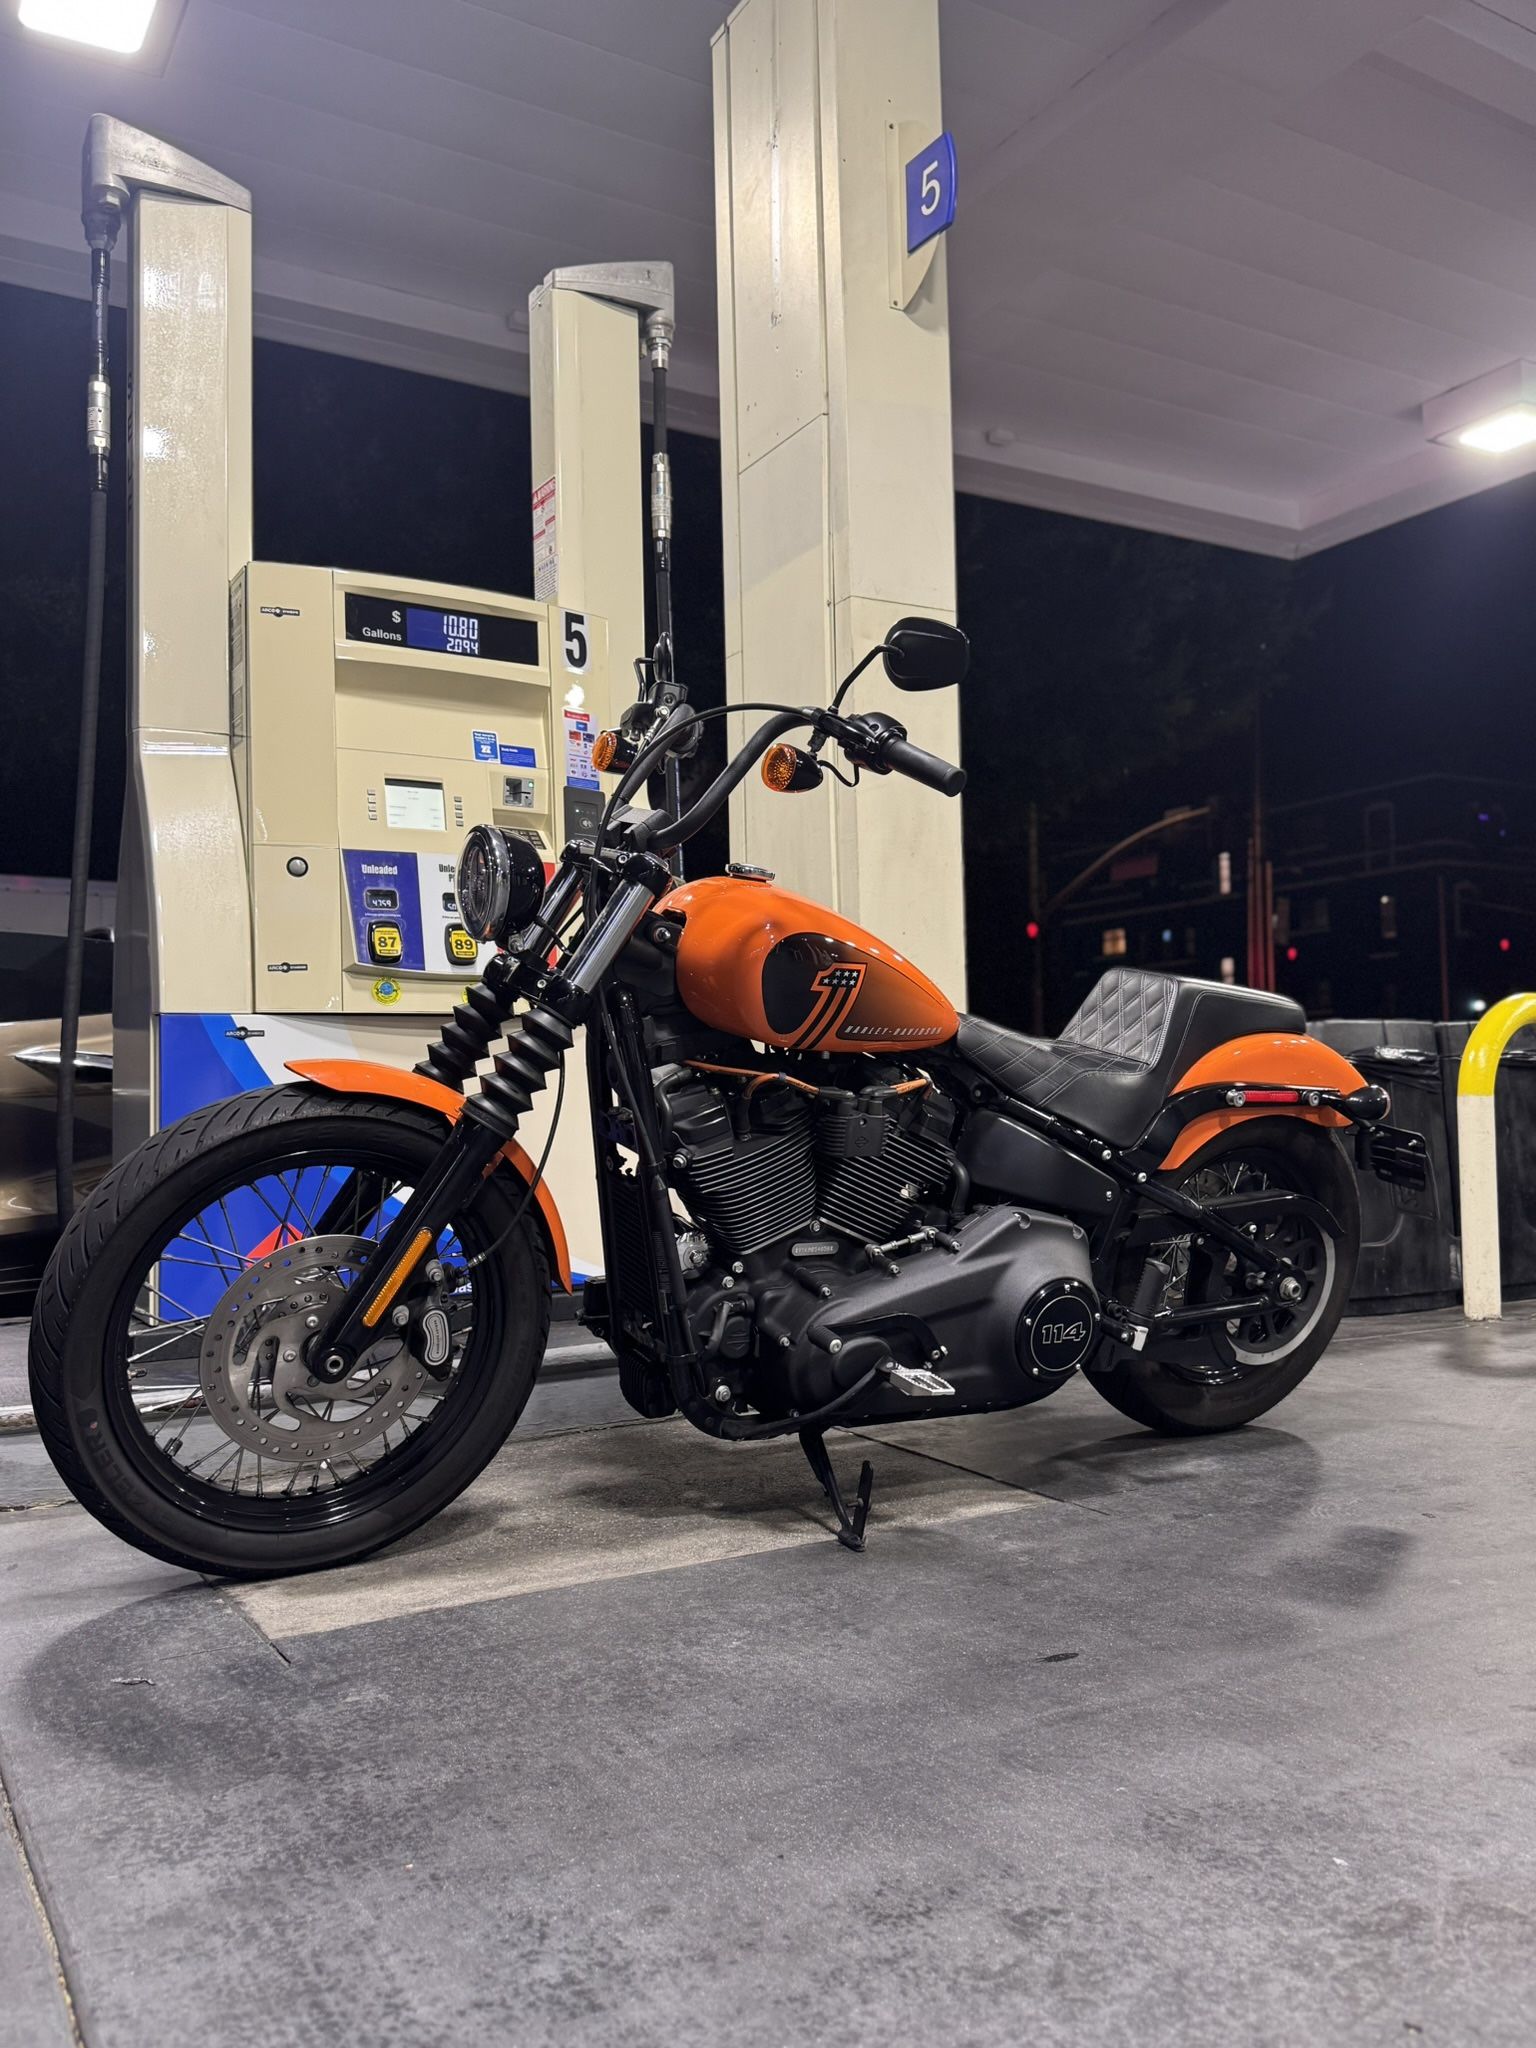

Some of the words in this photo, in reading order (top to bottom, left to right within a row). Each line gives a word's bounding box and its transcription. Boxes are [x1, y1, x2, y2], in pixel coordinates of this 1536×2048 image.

[921, 160, 940, 215] 5
[392, 610, 401, 623] $
[362, 627, 402, 641] Gallons
[565, 611, 587, 668] 5
[361, 864, 398, 874] Unleaded
[438, 863, 455, 873] Unle
[378, 936, 397, 948] 87
[455, 939, 474, 950] 89
[844, 1025, 943, 1036] HARLEY-DAVIDSON
[1042, 1321, 1087, 1344] 114
